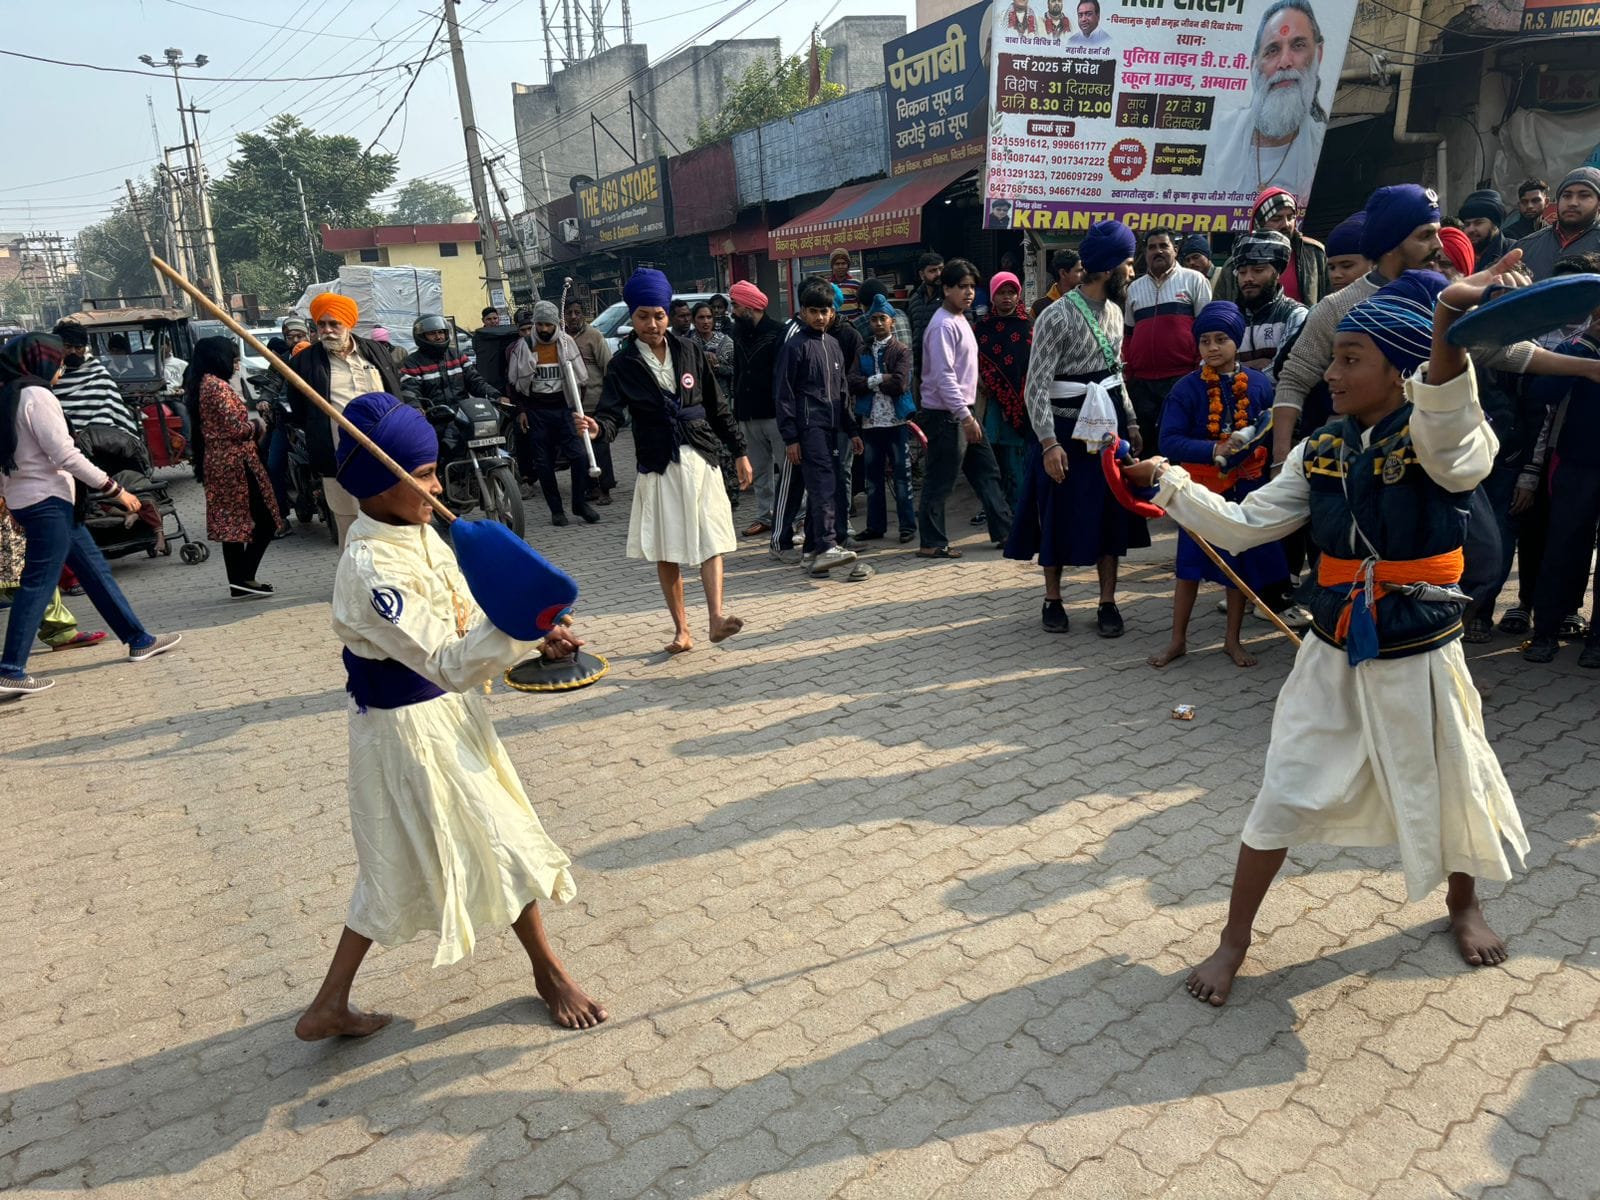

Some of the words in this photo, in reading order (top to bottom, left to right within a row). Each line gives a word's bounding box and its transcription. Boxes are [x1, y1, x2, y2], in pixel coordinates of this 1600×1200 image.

[1200, 19, 1210, 29] की
[1524, 12, 1547, 30] R.S.
[1052, 38, 1061, 47] जी
[1101, 47, 1111, 55] जी
[888, 24, 967, 92] पंजाबी
[1012, 57, 1030, 71] वर्ष
[1031, 61, 1059, 72] 2025
[1061, 60, 1073, 73] में
[1075, 61, 1100, 74] प्रवेश
[1122, 47, 1160, 67] पुलिस
[1163, 51, 1198, 68] लाइन
[1201, 51, 1250, 70] डी.ए.वी.
[1003, 75, 1038, 93] विशेष
[1048, 82, 1061, 94] 31
[1065, 79, 1112, 97] दिसम्बर
[1121, 71, 1151, 89] स्कूल
[1201, 76, 1248, 91] अम्बाला
[896, 96, 930, 121] चिकन
[932, 88, 951, 116] सूप
[954, 84, 965, 102] व
[1001, 93, 1026, 109] रात्रि
[1030, 98, 1059, 110] 8.30
[1060, 96, 1074, 112] से
[1078, 101, 1111, 113] 12.00
[1165, 100, 1179, 112] 27
[1180, 98, 1192, 113] से
[1194, 101, 1206, 113] 31
[1121, 113, 1129, 124] 3
[1130, 111, 1140, 124] से
[1142, 114, 1149, 124] 6
[1160, 113, 1202, 129] दिसम्बर
[896, 120, 927, 149] खरोड़े
[928, 119, 946, 137] का
[947, 112, 968, 140] सूप
[991, 136, 1049, 150] 9215591612,
[1052, 140, 1107, 150] 9996611777
[580, 186, 600, 219] THE
[601, 179, 619, 212] 499
[620, 166, 658, 207] STORE
[1162, 188, 1172, 200] श्री
[1172, 191, 1190, 203] कृष्ण
[1191, 192, 1207, 203] कृपा
[1228, 190, 1244, 201] गीता
[1122, 211, 1229, 232] CHOPRA
[536, 366, 560, 379] UM
